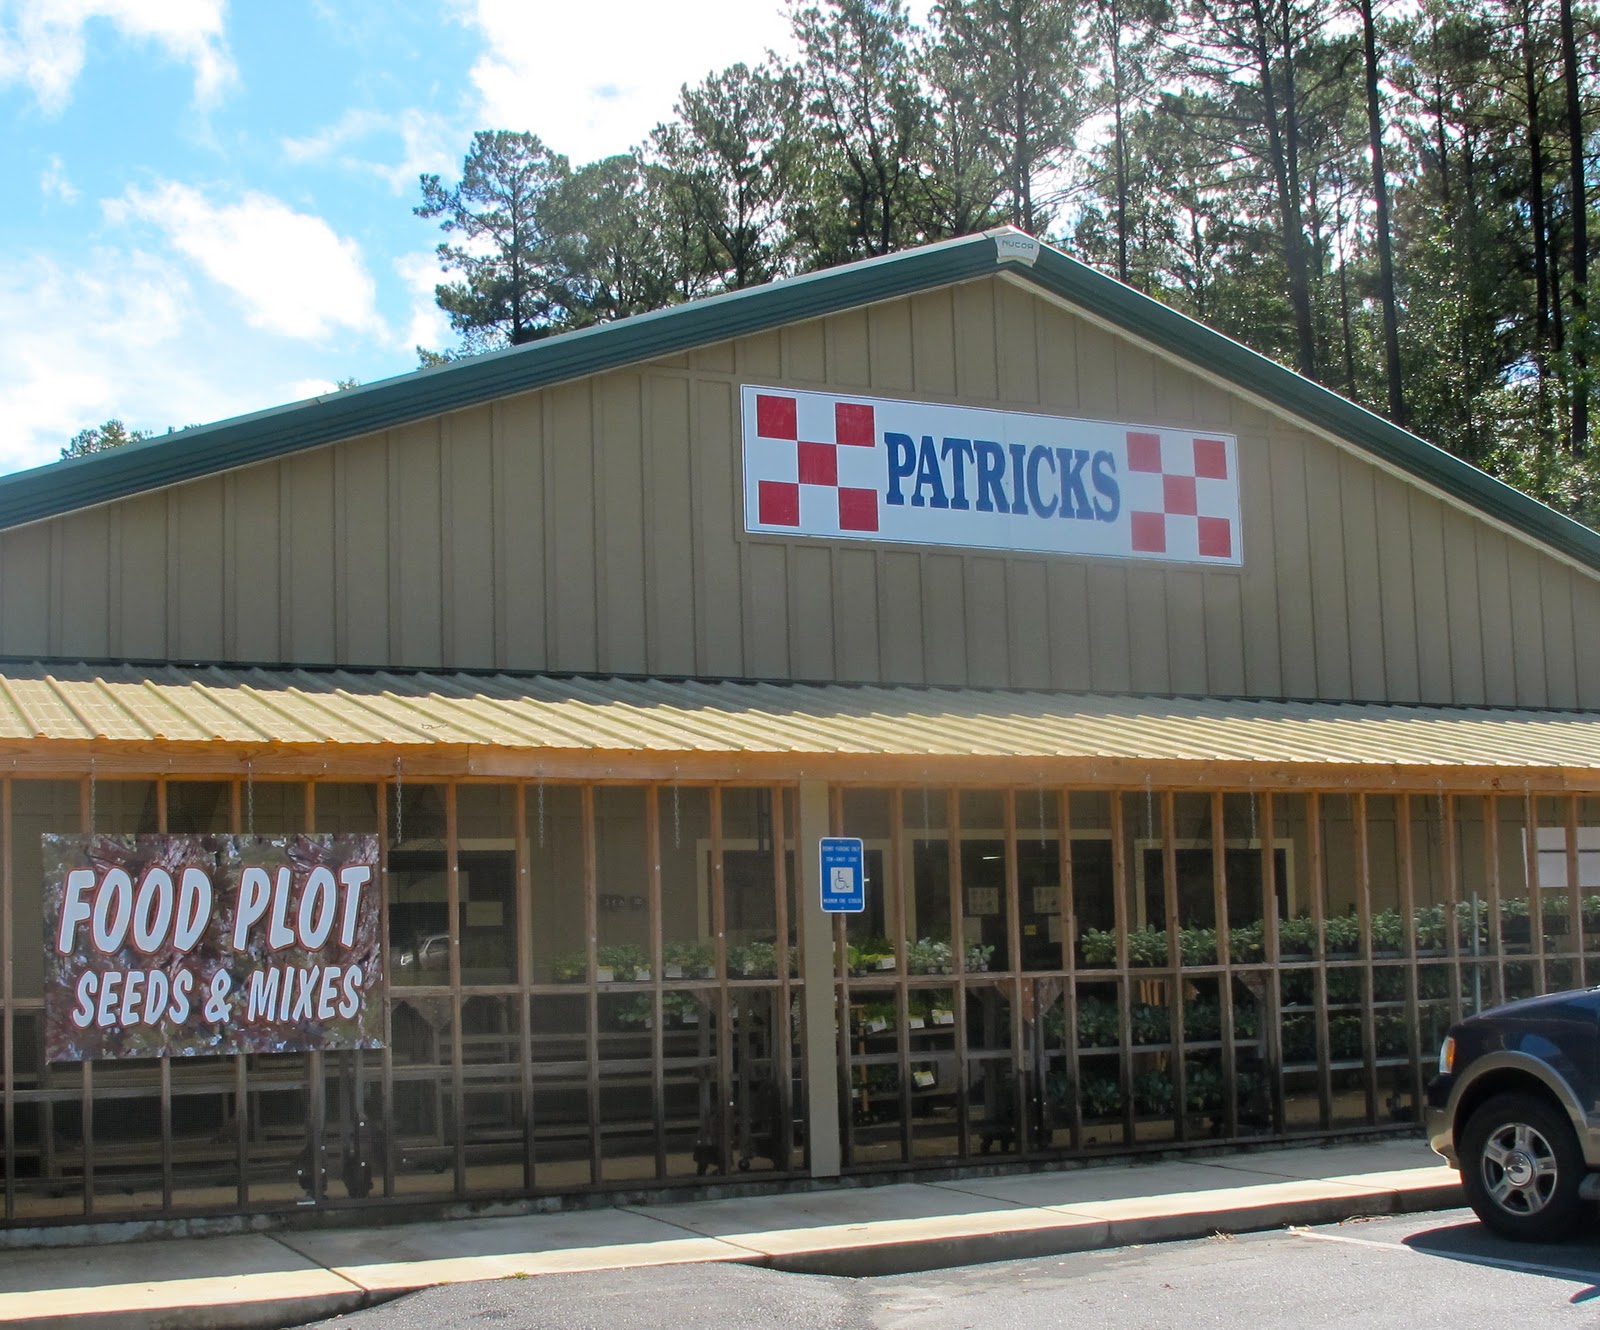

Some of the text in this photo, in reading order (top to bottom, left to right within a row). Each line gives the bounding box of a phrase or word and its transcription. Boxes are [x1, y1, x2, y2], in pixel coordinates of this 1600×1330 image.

[1001, 240, 1034, 250] NUCOR
[884, 431, 1121, 523] PATRICKS
[57, 865, 372, 954] FOOD PLOT
[71, 964, 363, 1028] SEEDS & MIXES
